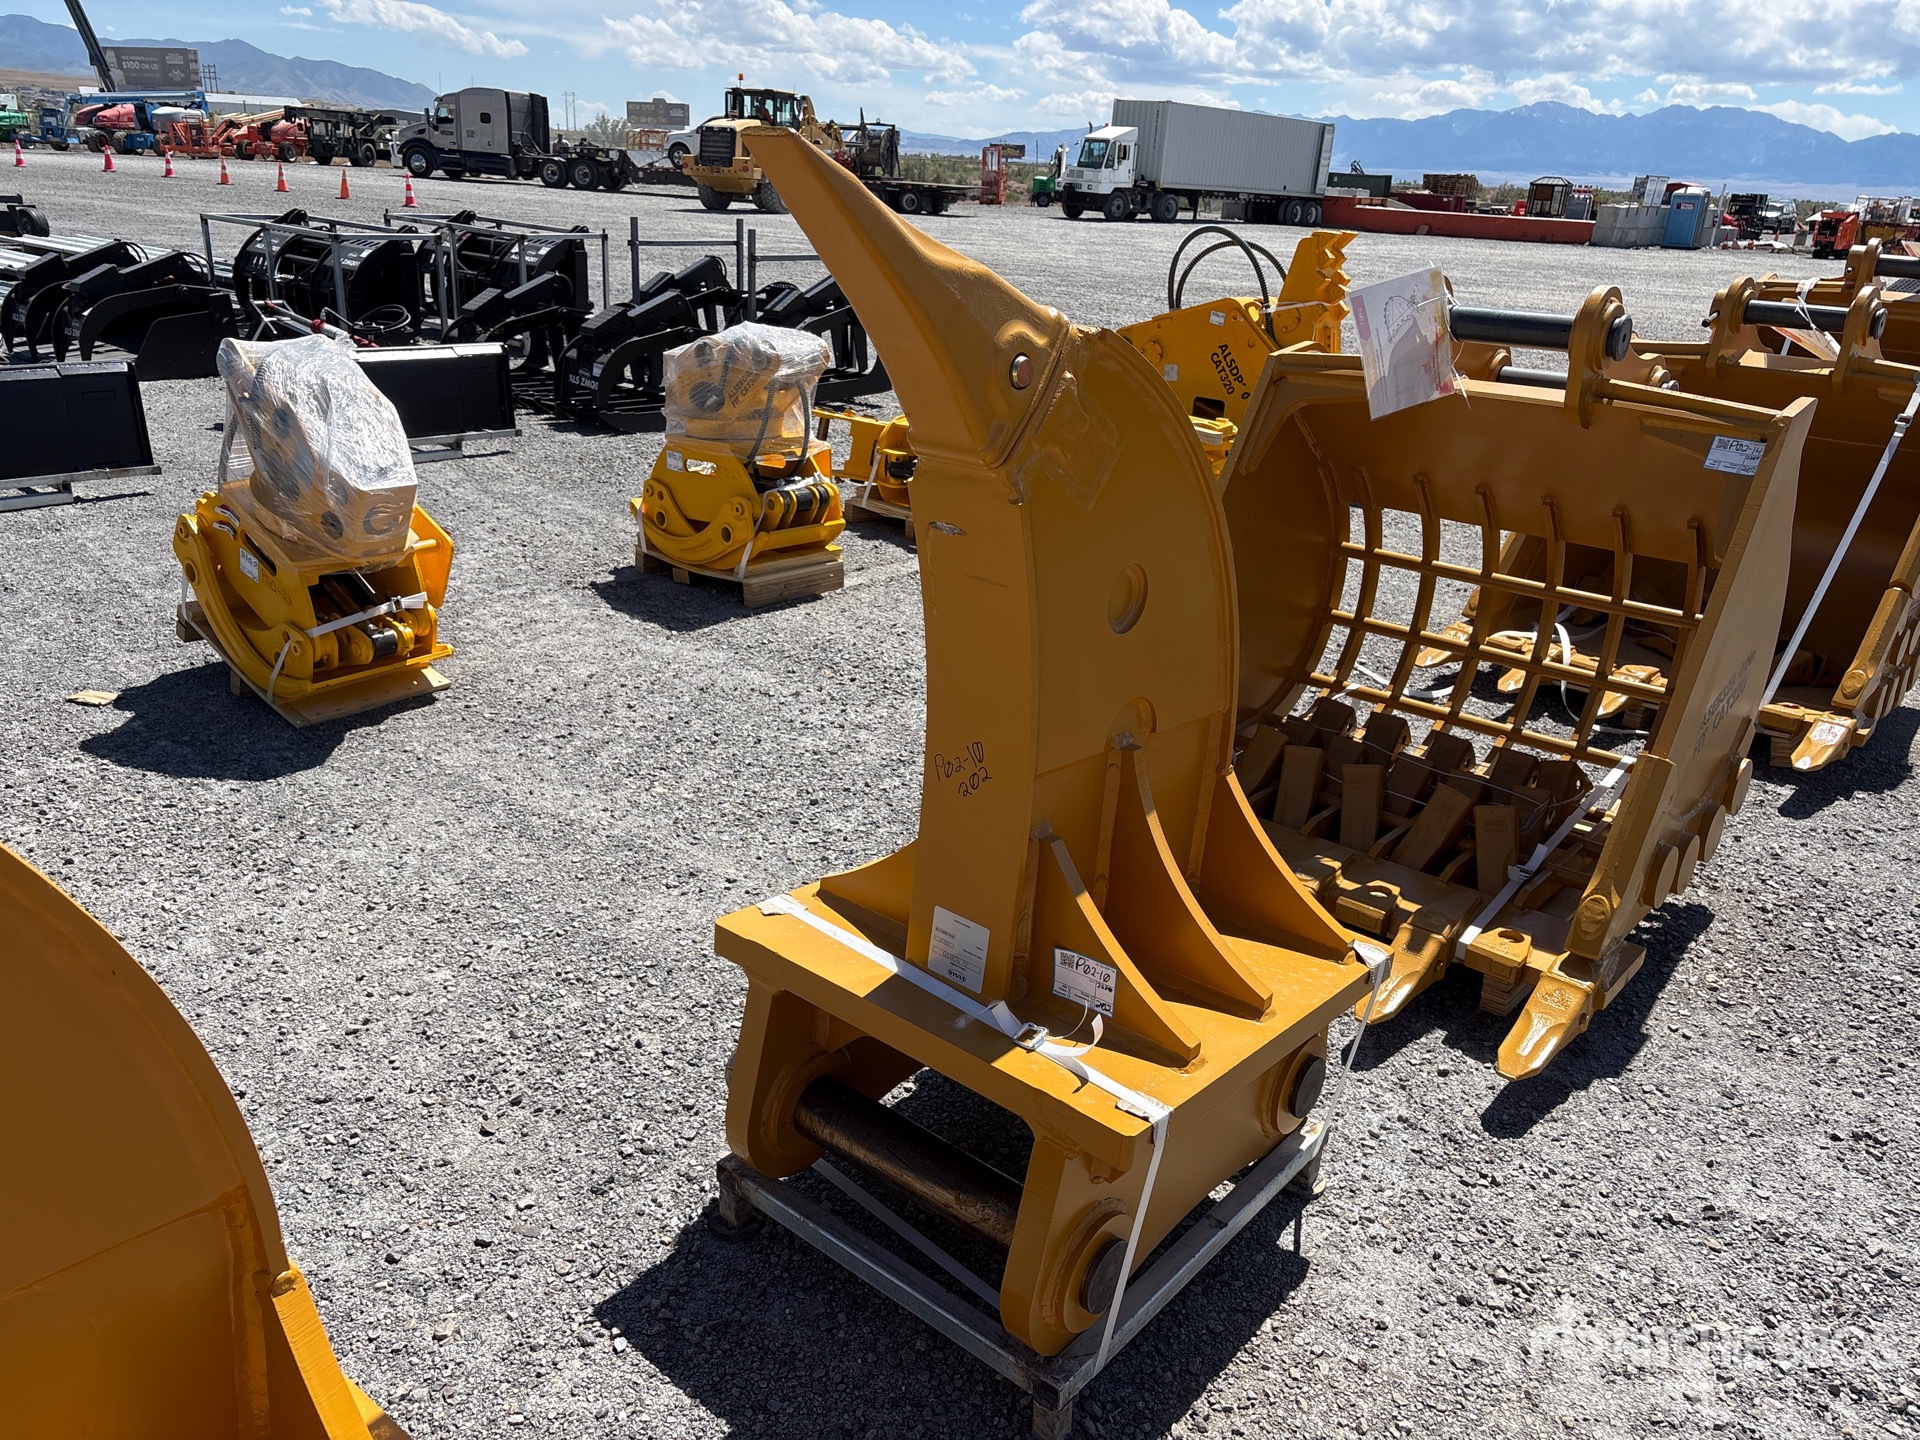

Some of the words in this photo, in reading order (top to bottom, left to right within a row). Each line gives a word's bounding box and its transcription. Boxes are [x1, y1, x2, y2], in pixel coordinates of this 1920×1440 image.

[121, 61, 140, 70] $100
[140, 62, 150, 70] ON
[569, 373, 580, 385] ALS
[580, 376, 599, 391] ZMQ0
[1210, 352, 1235, 396] CAT320
[1217, 343, 1251, 400] ALSDP0
[1729, 439, 1763, 456] P02-14
[934, 741, 984, 781] P02-10
[958, 766, 993, 797] 202
[1075, 956, 1111, 983] P02-10
